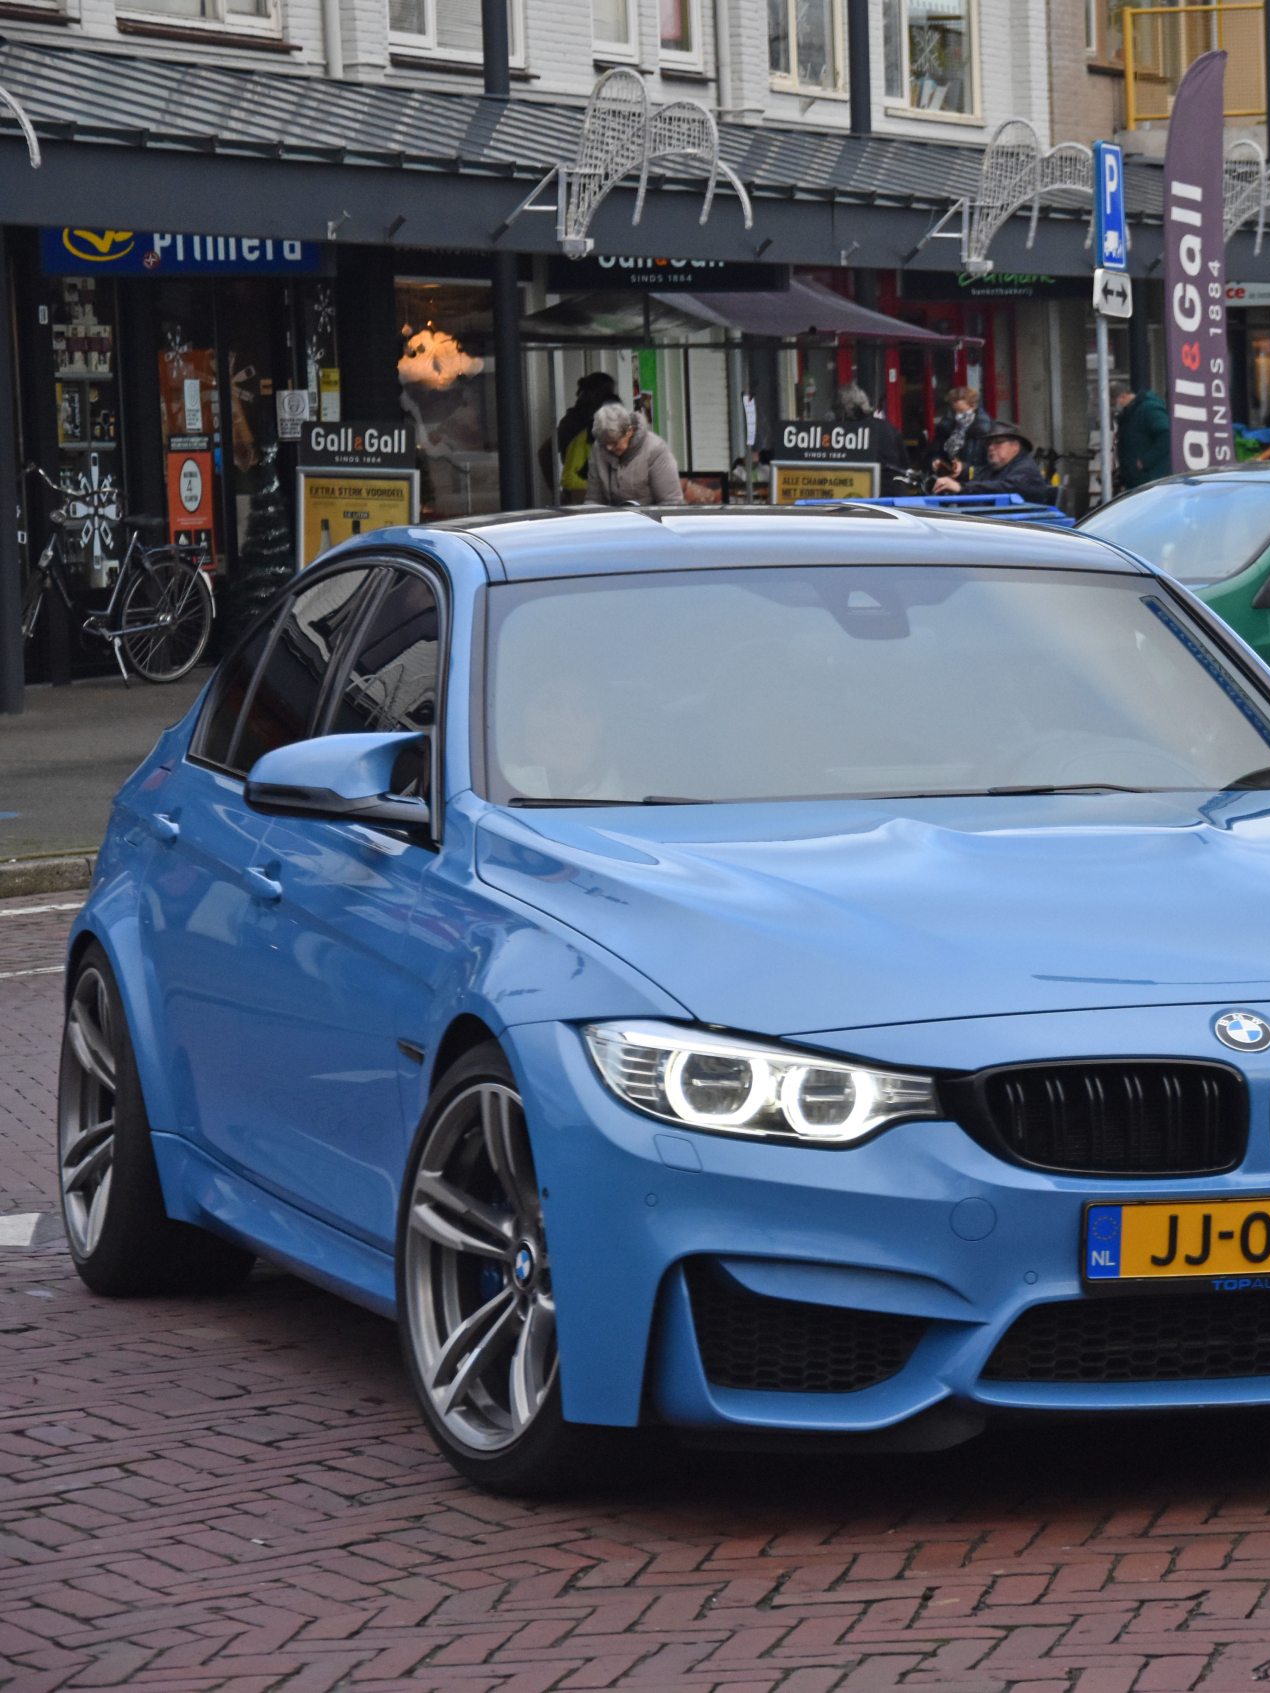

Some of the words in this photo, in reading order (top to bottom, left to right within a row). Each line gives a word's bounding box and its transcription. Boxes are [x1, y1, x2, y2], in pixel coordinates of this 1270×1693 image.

[1105, 154, 1118, 215] P
[630, 274, 663, 283] SINDS
[668, 274, 693, 283] 1884
[1207, 260, 1223, 336] 1884
[1170, 181, 1210, 471] all&Gall
[1208, 358, 1231, 461] SINDS
[311, 426, 406, 454] Gall&Gall
[783, 425, 870, 450] Gall&Gall
[804, 451, 827, 459] SINDS
[309, 486, 336, 496] EXTRA
[338, 487, 363, 497] STERK
[365, 488, 404, 498] VOORDEEL
[782, 476, 800, 486] ALLE
[802, 477, 854, 487] CHAMPAGNES
[1091, 1250, 1116, 1267] NL
